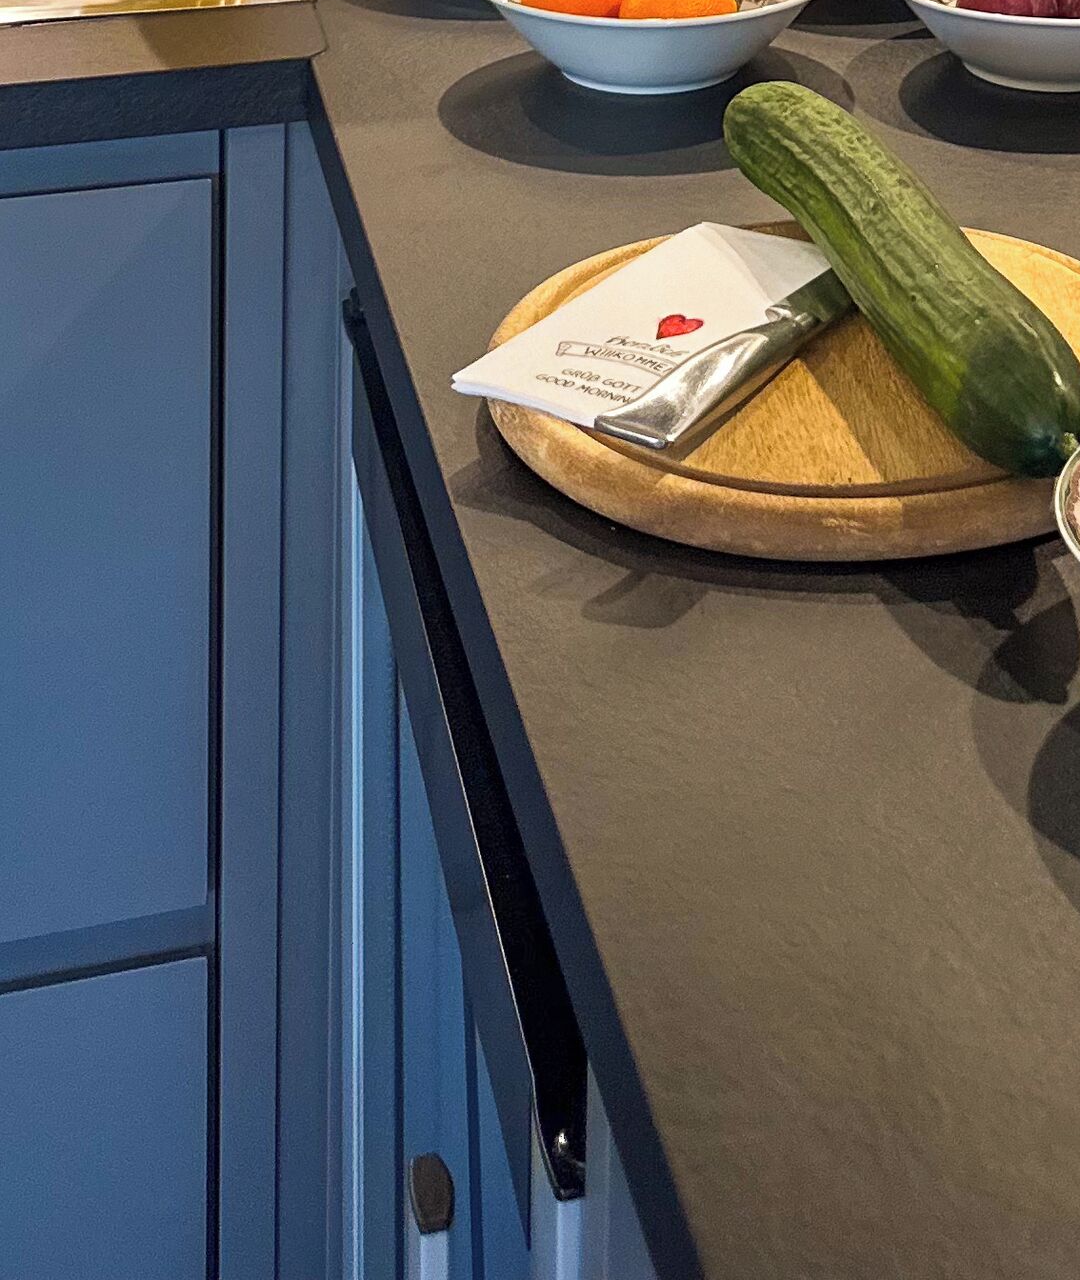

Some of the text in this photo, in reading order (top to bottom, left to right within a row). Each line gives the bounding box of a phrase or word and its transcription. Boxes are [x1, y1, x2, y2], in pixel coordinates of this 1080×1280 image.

[535, 373, 632, 404] GOOD MORNIN
[601, 378, 642, 393] GOTT
